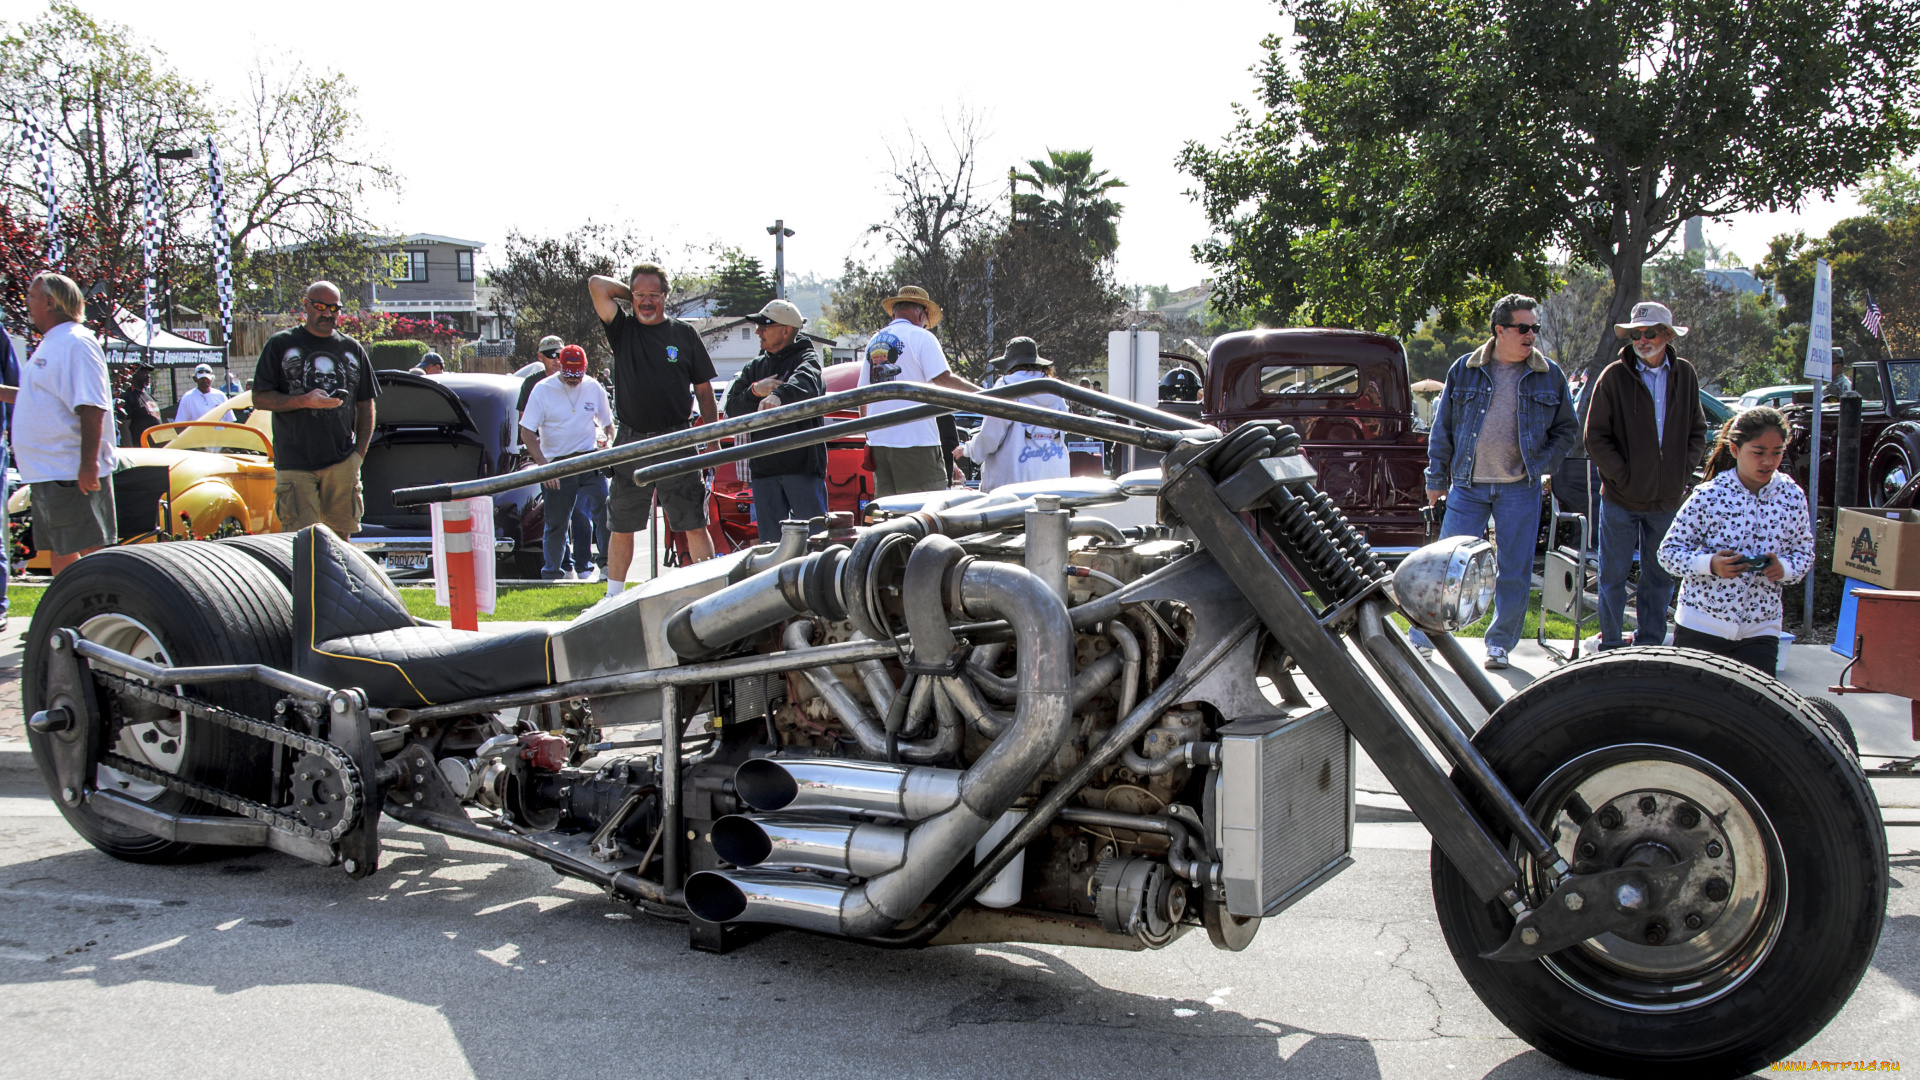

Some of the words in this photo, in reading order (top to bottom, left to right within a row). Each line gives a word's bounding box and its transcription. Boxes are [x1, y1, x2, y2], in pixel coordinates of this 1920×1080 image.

[153, 350, 165, 363] Car
[164, 350, 199, 365] Appearance
[199, 351, 223, 363] Products
